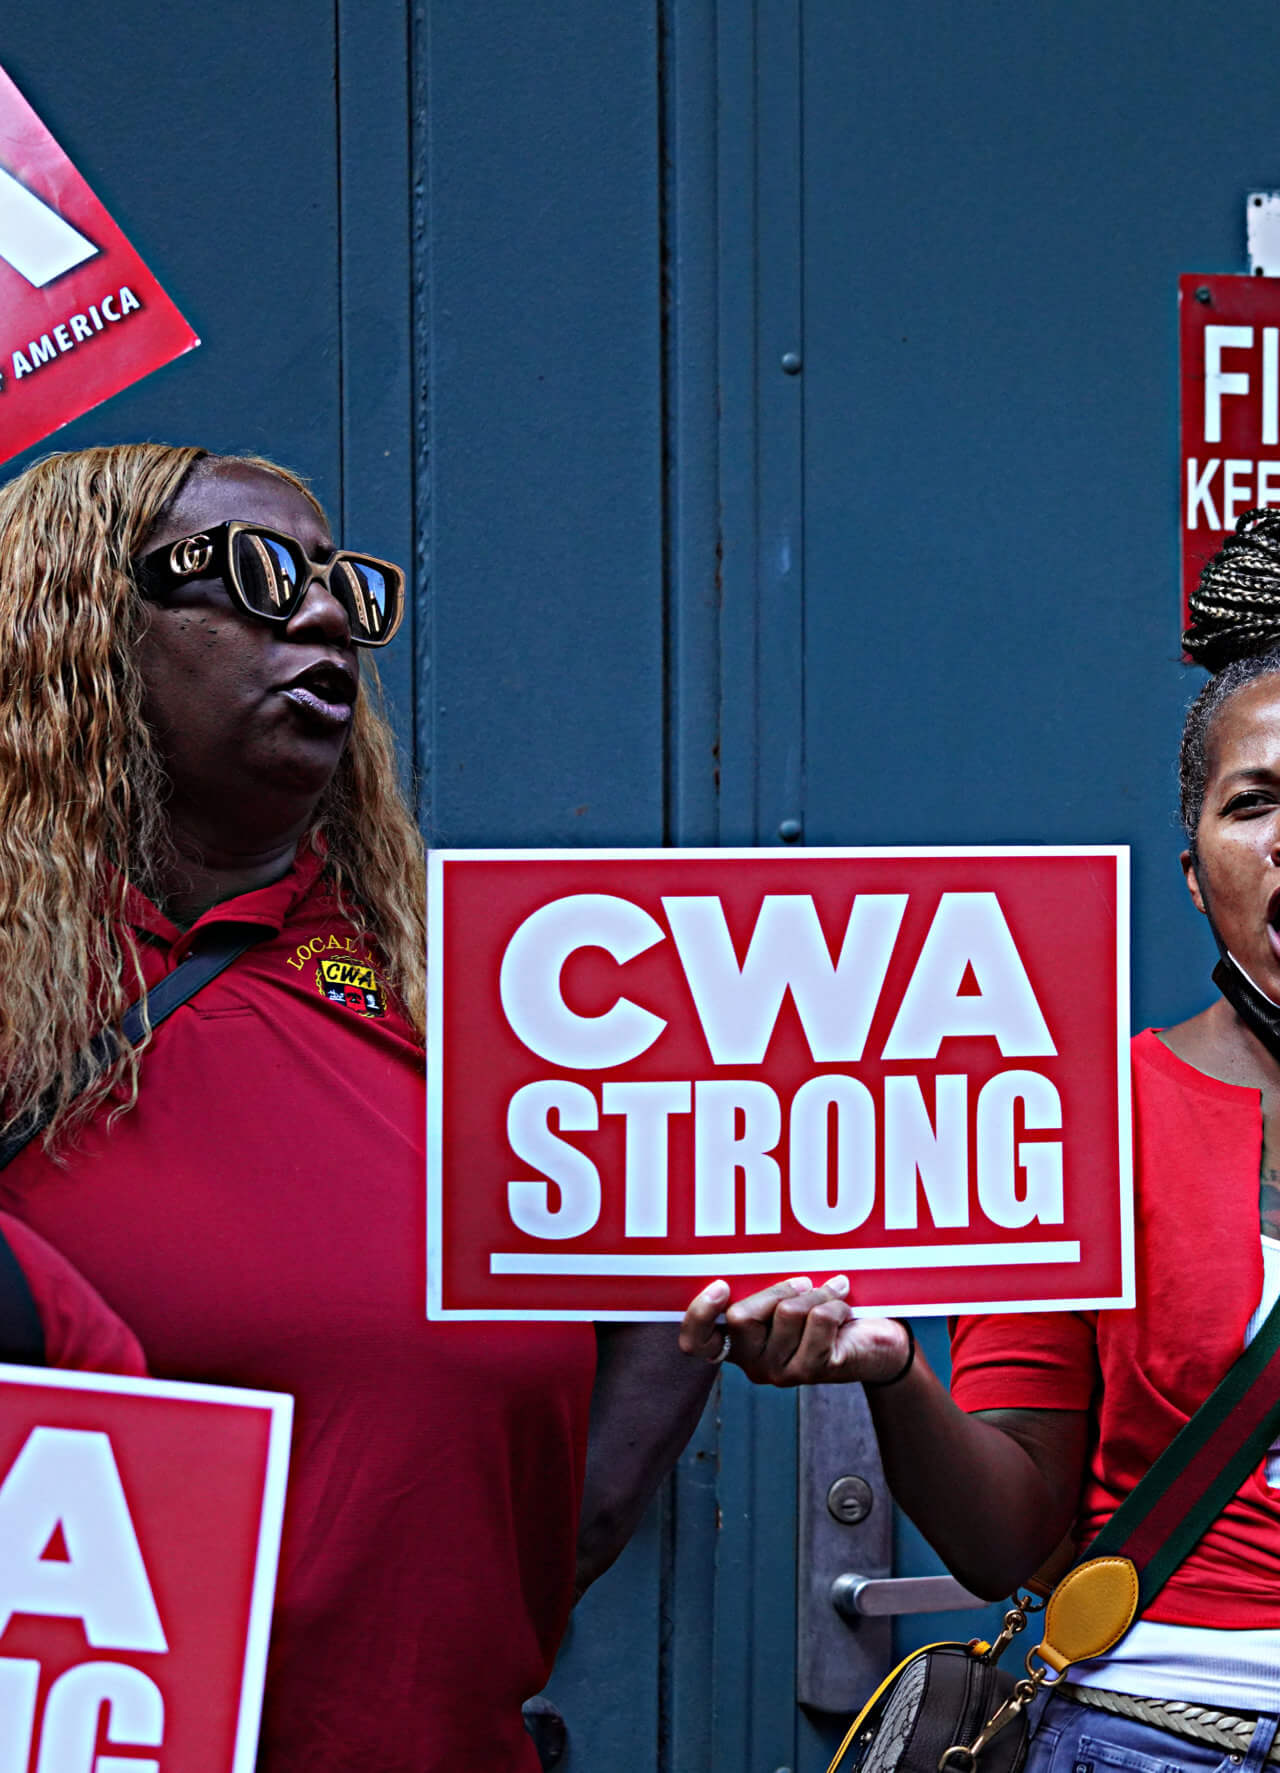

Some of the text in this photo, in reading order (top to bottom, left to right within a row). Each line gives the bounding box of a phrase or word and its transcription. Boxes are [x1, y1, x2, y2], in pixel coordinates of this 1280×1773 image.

[12, 286, 140, 379] AMERICA
[287, 934, 358, 971] LOCAL
[326, 963, 373, 988] CWA
[500, 892, 1058, 1070] CWA
[507, 1070, 1064, 1240] STRONG
